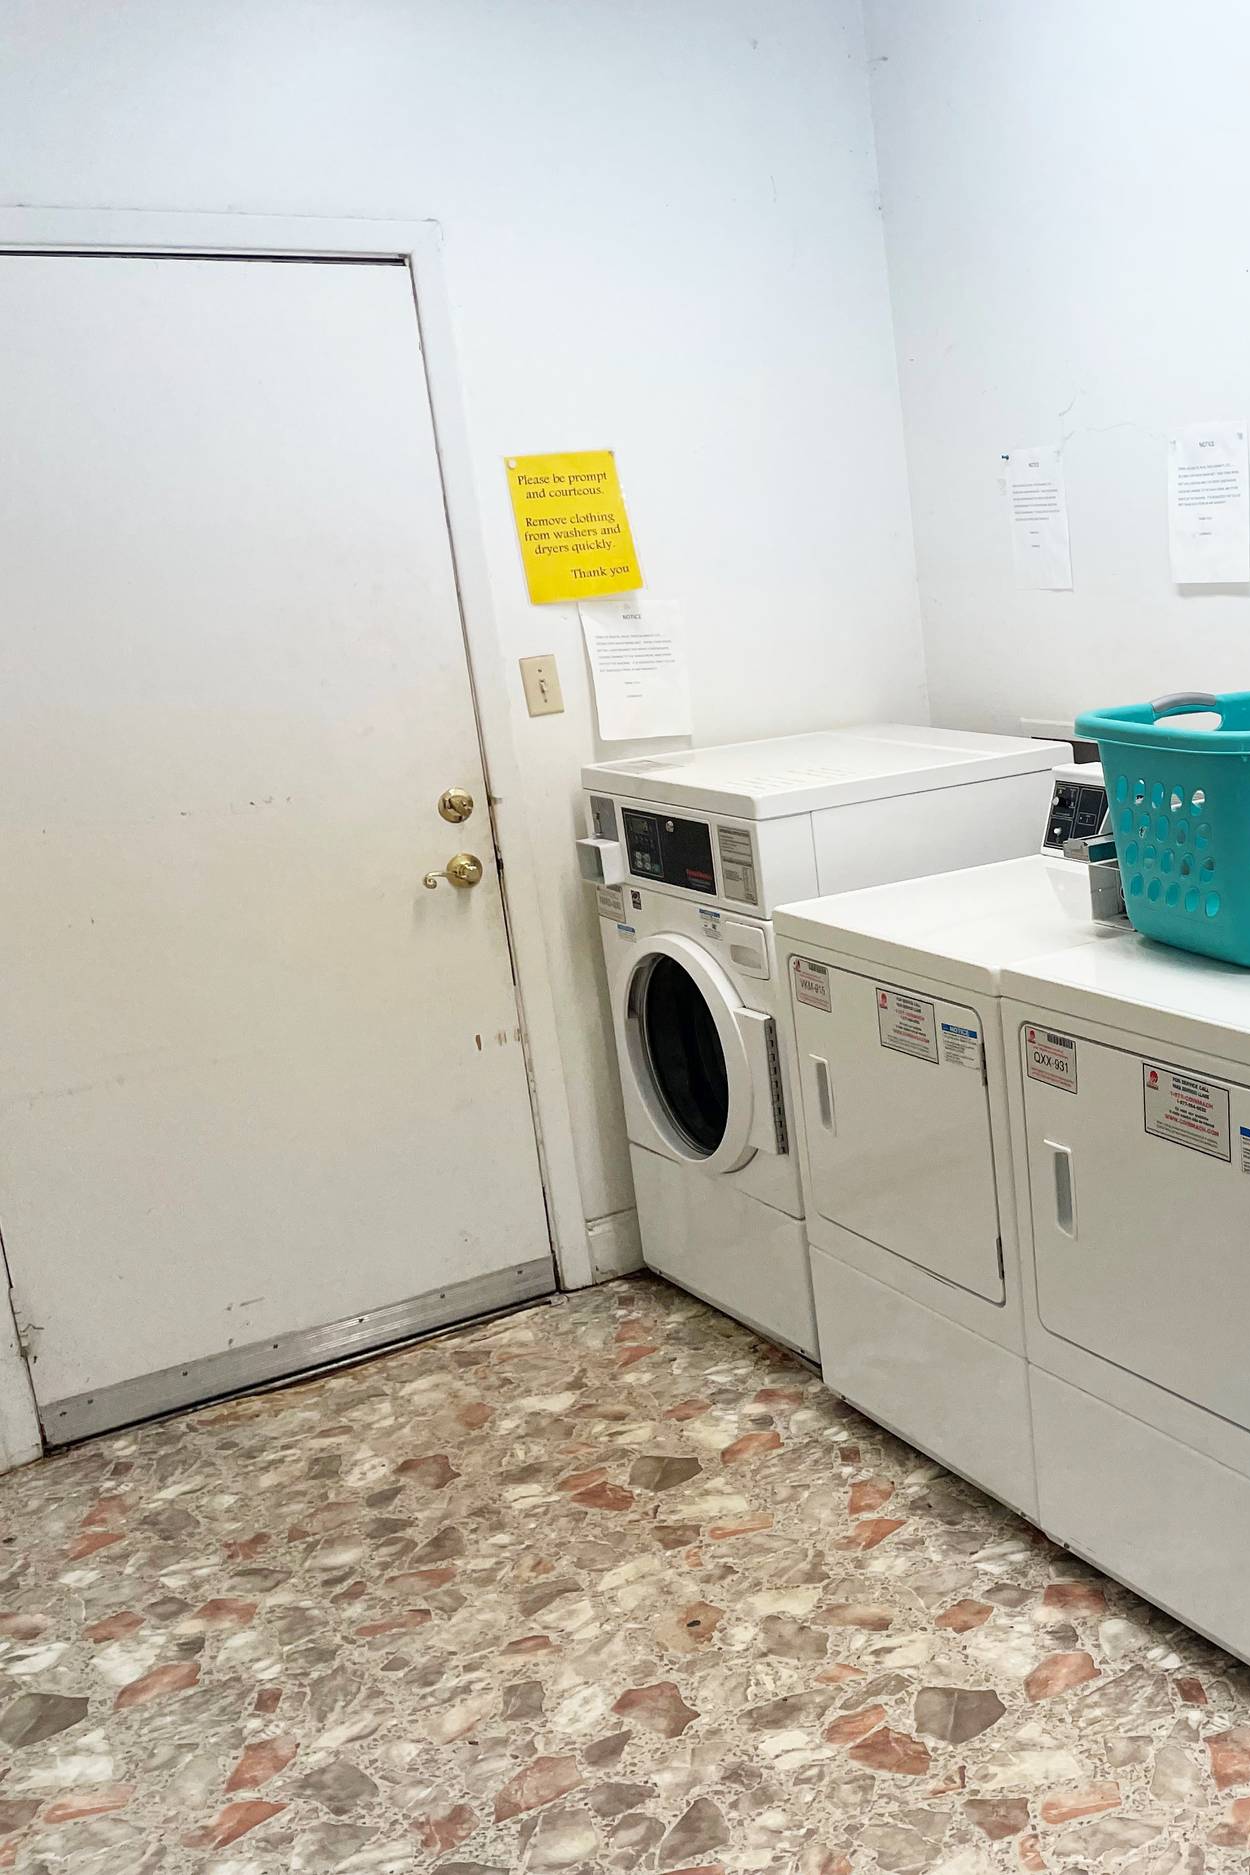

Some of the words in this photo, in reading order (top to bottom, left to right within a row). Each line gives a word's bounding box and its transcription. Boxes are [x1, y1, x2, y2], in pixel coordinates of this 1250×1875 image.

[517, 475, 550, 486] Please
[553, 474, 565, 483] be
[568, 472, 608, 485] prompt
[526, 488, 546, 499] and
[549, 486, 604, 499] courteous.
[525, 516, 567, 528] Remove
[569, 512, 615, 524] clothing
[524, 531, 550, 542] from
[553, 527, 598, 540] washers
[600, 524, 621, 535] and
[534, 544, 569, 556] dryers
[571, 539, 616, 554] quickly.
[571, 567, 607, 579] Thank
[610, 565, 629, 577] you
[1033, 1051, 1069, 1074] QXX-931
